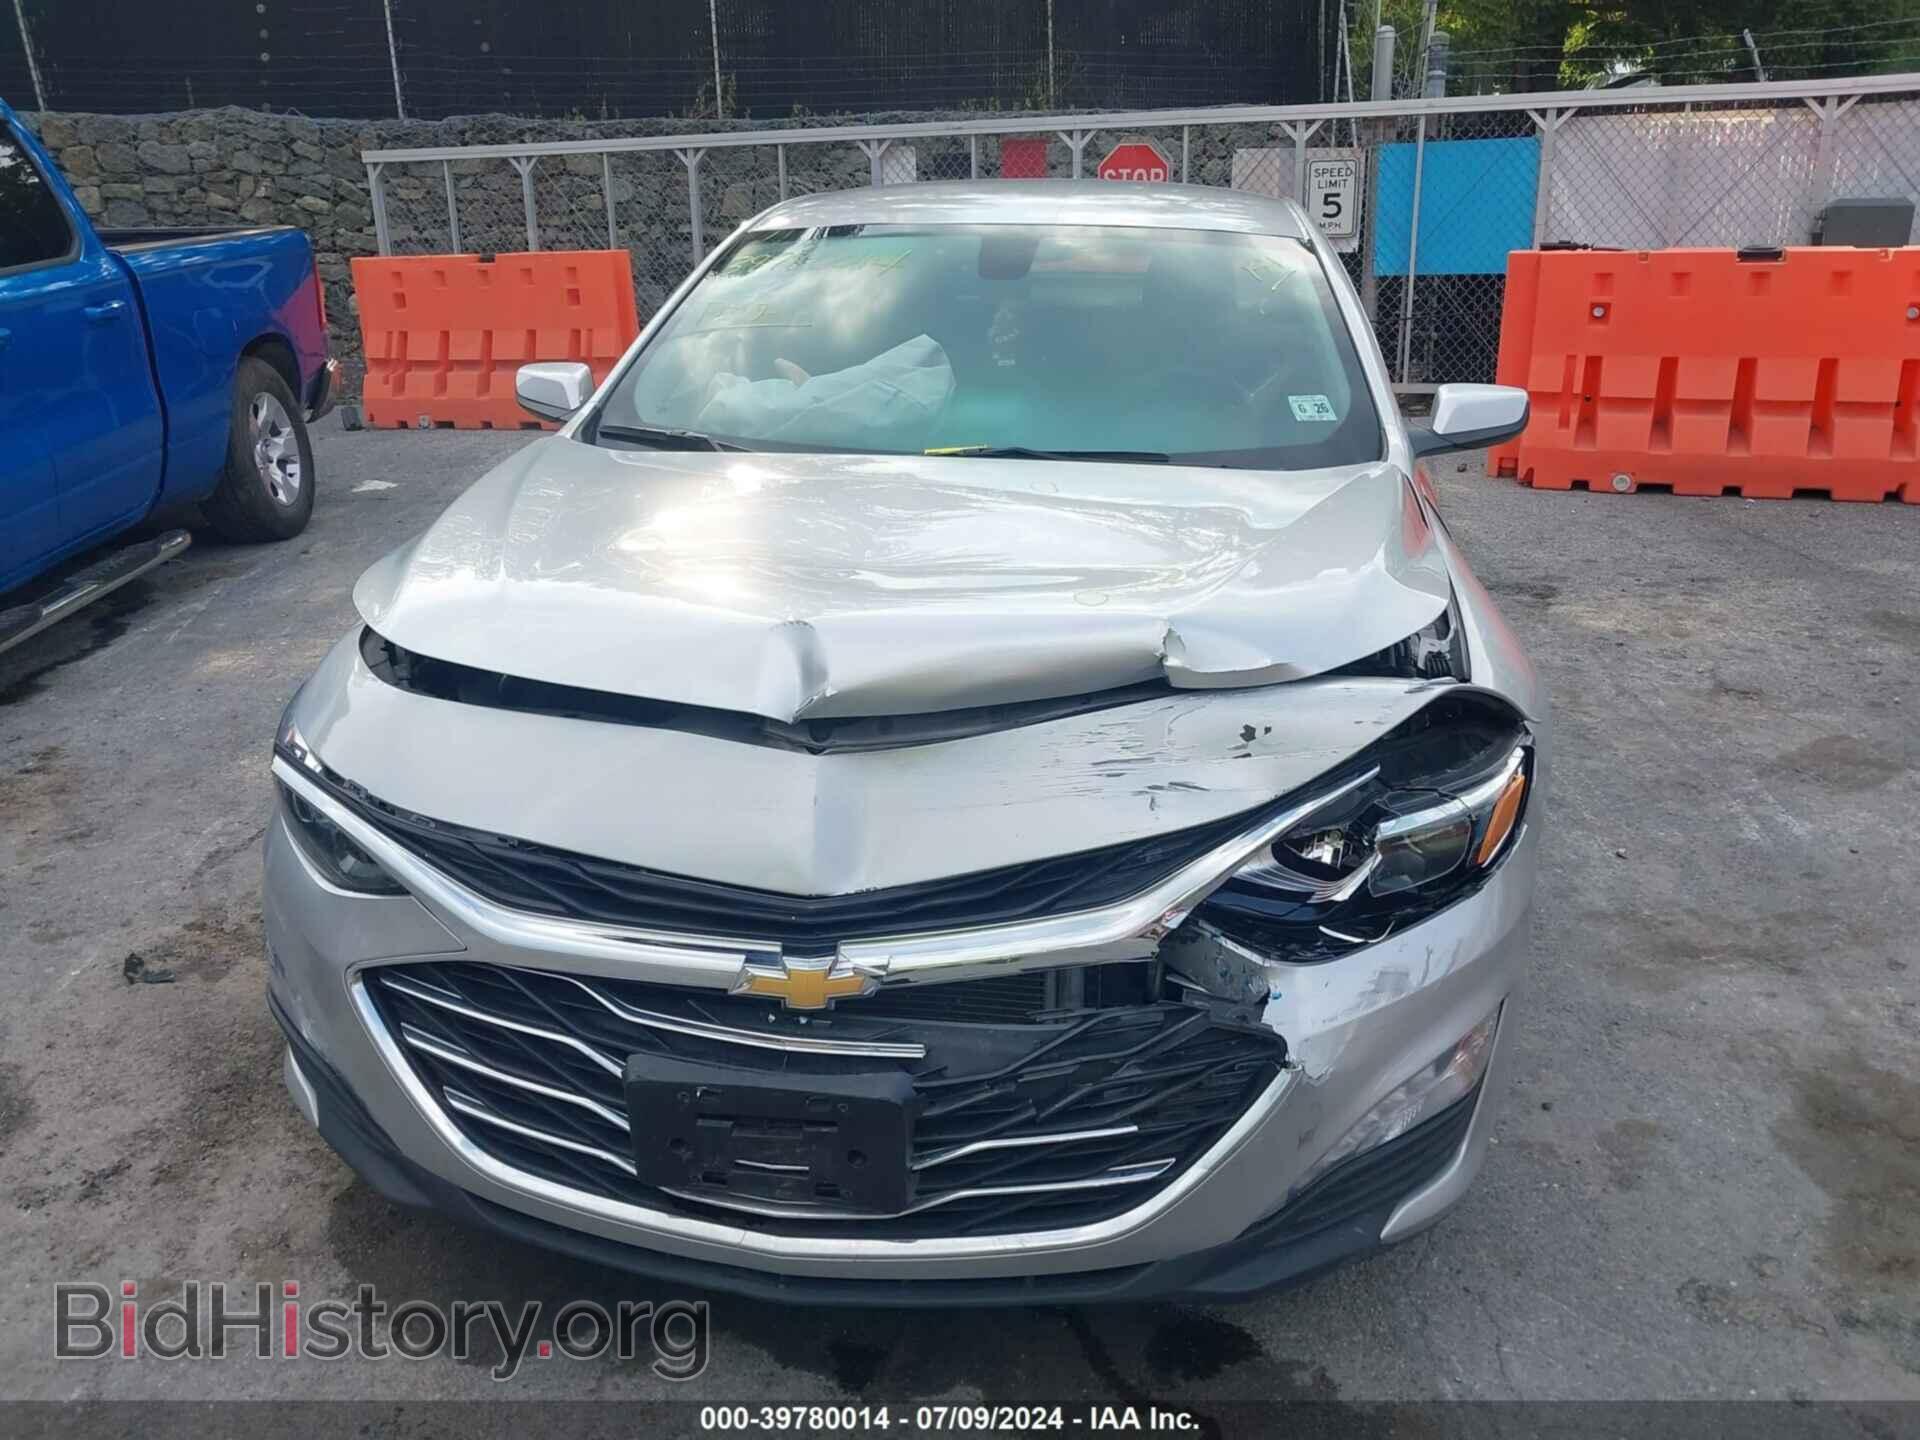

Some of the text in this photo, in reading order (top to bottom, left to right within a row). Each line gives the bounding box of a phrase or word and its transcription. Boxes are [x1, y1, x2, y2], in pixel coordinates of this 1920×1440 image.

[1313, 167, 1353, 178] SPEED
[1318, 179, 1348, 189] LIMIT
[1322, 193, 1342, 218] 5
